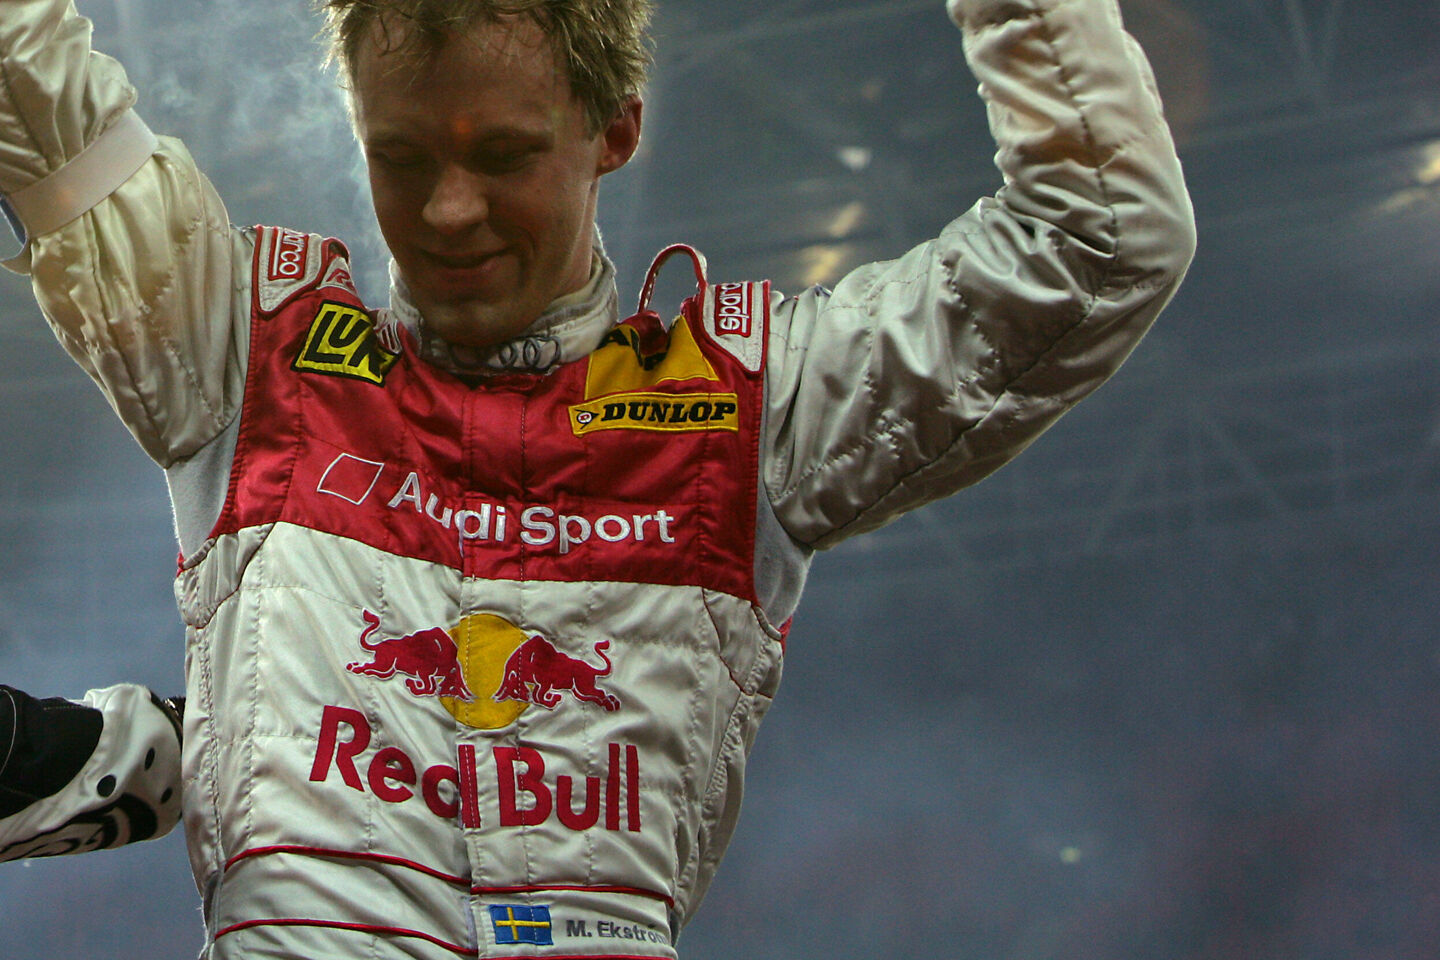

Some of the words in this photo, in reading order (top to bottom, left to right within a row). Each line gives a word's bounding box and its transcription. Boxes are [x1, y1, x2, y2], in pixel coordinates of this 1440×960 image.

[601, 402, 736, 423] DUNLOP
[387, 471, 505, 543] Audi
[521, 505, 675, 554] Sport
[309, 705, 481, 828] Red
[493, 743, 641, 833] Bull
[566, 920, 592, 937] M.
